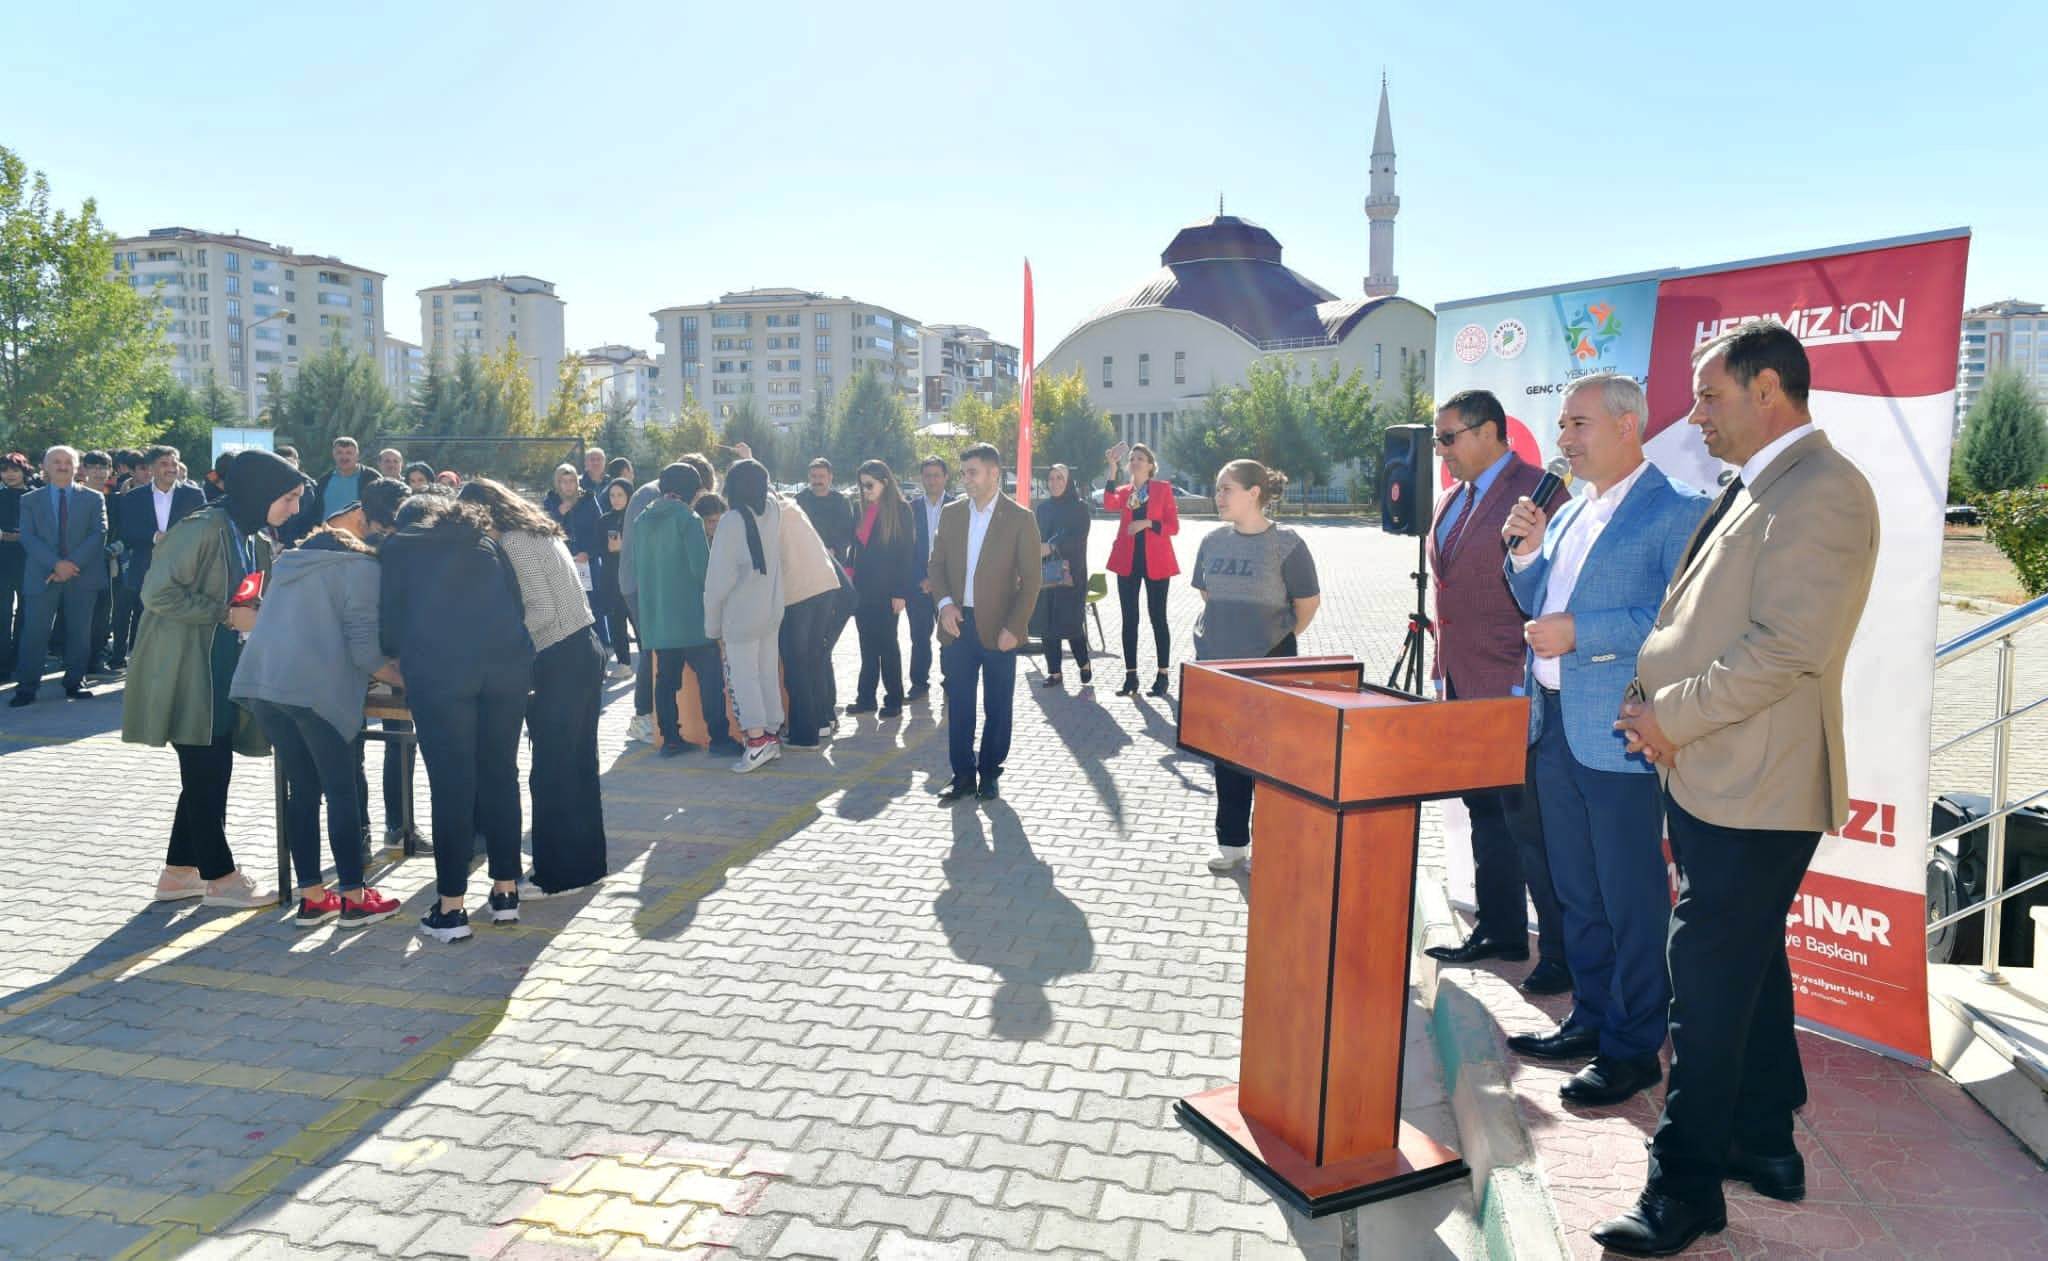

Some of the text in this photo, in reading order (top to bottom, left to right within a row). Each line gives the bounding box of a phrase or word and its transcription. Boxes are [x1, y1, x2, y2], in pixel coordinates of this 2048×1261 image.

[1526, 385, 1554, 395] GENÇ
[1829, 799, 1896, 847] Z!
[1806, 935, 1868, 966] Başkanı
